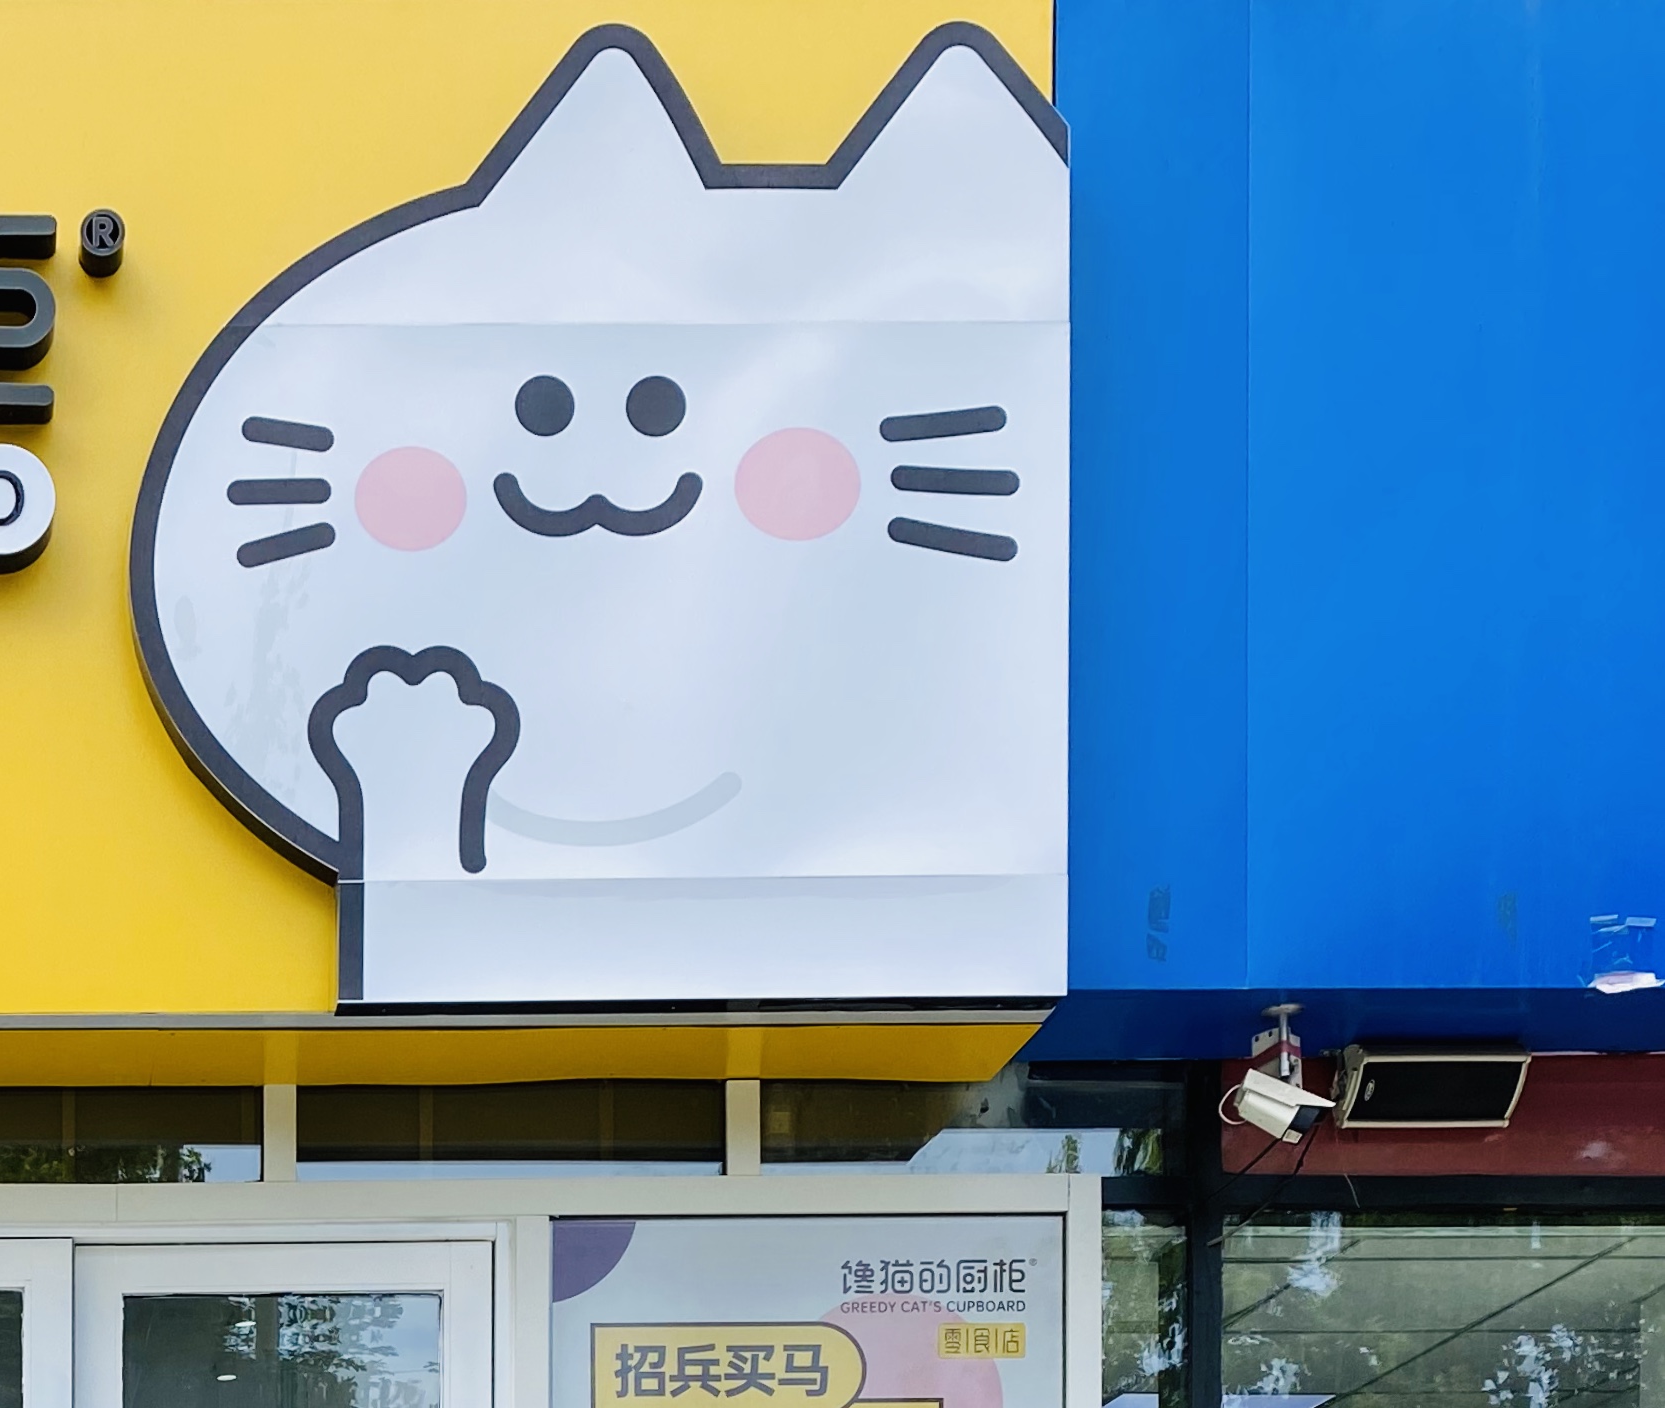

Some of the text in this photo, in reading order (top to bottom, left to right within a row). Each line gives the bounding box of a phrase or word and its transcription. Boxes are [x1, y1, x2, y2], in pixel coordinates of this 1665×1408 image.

[841, 1259, 1025, 1294] 馋猫的厨柜
[841, 1301, 1026, 1313] GREEDY CAT'S CUPBOARD
[615, 1344, 829, 1398] 招兵买马
